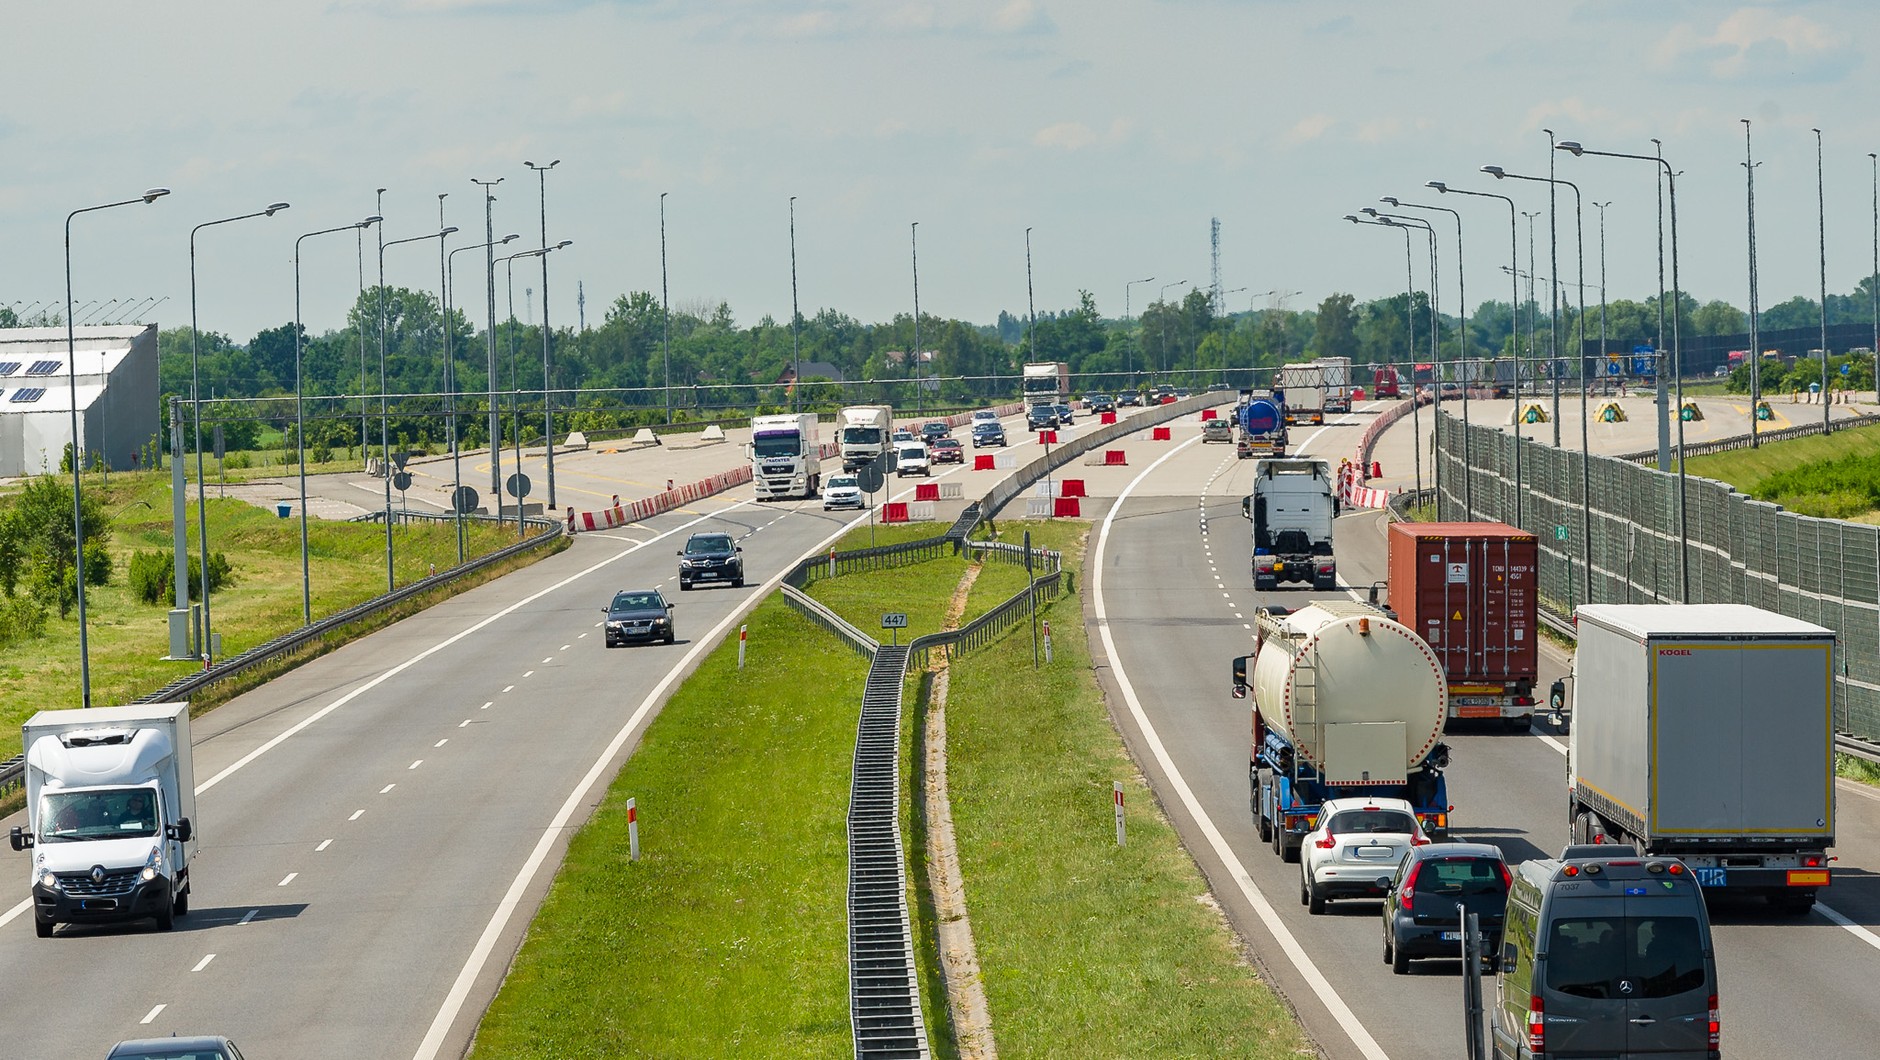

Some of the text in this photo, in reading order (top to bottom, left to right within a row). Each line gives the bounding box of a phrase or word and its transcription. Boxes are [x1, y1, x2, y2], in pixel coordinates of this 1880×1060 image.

[884, 615, 905, 625] 447
[1698, 869, 1724, 885] TIR
[1561, 883, 1580, 891] 7037
